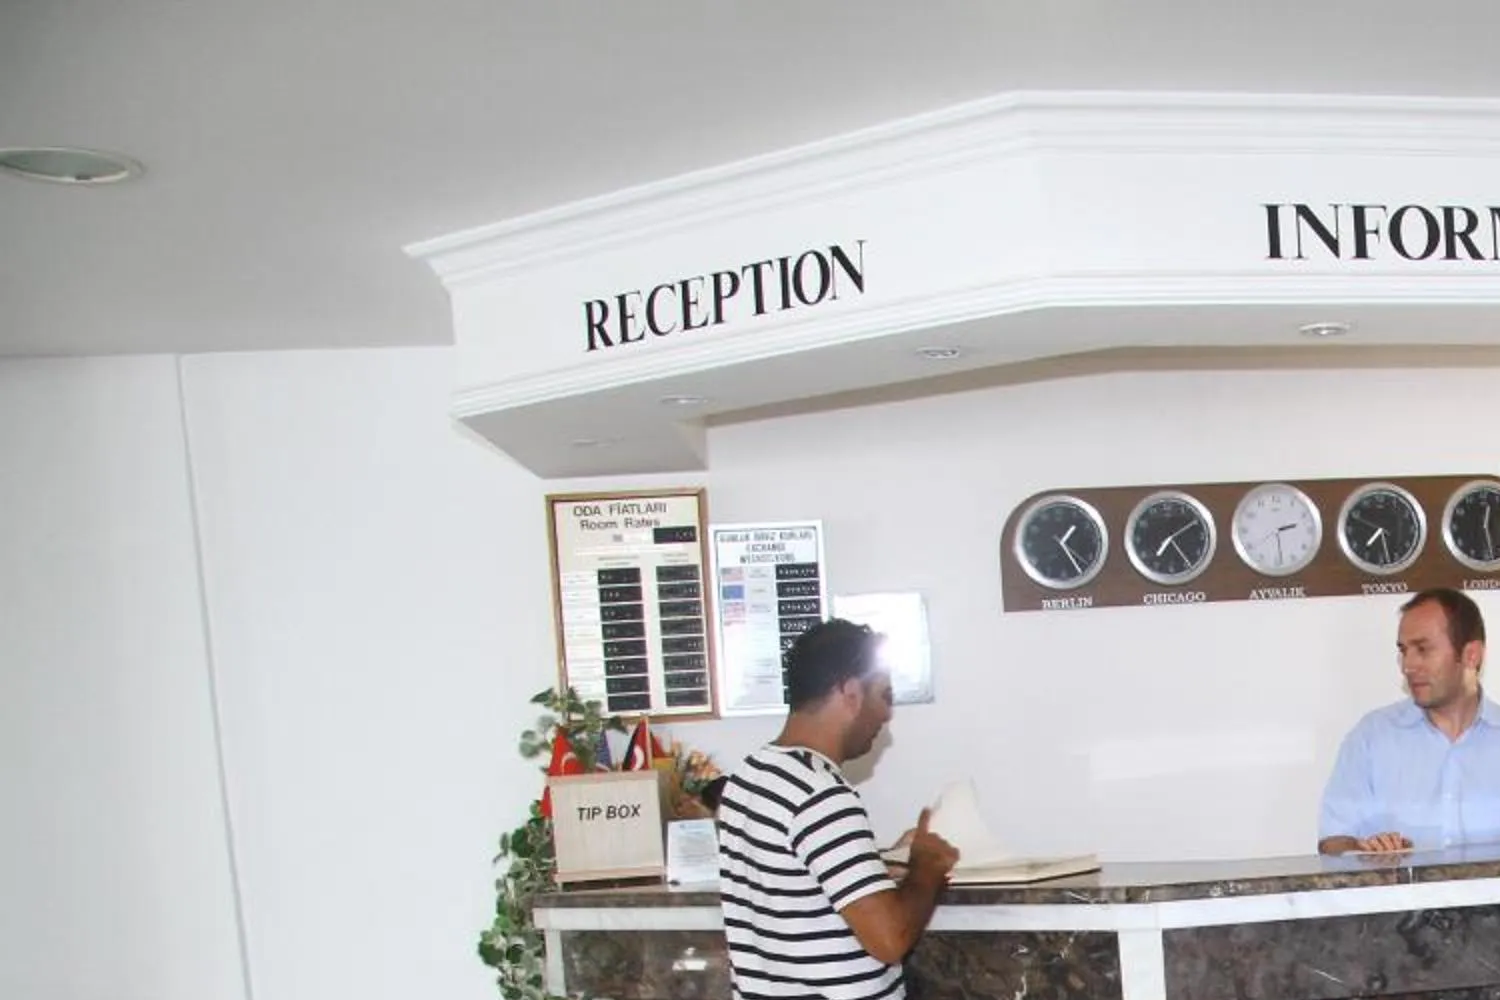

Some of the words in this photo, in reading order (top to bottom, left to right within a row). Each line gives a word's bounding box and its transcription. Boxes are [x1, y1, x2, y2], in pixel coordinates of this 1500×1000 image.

[583, 240, 867, 352] RECEPTION
[573, 505, 602, 517] ODA
[580, 518, 618, 531] Room
[624, 515, 661, 529] Rates
[1250, 586, 1306, 601] AYVALIK
[1361, 581, 1409, 595] TOKYO
[1042, 596, 1093, 610] BERLIN
[1143, 591, 1206, 605] CHICAGO
[577, 806, 603, 821] TIP
[606, 804, 642, 819] BOX
